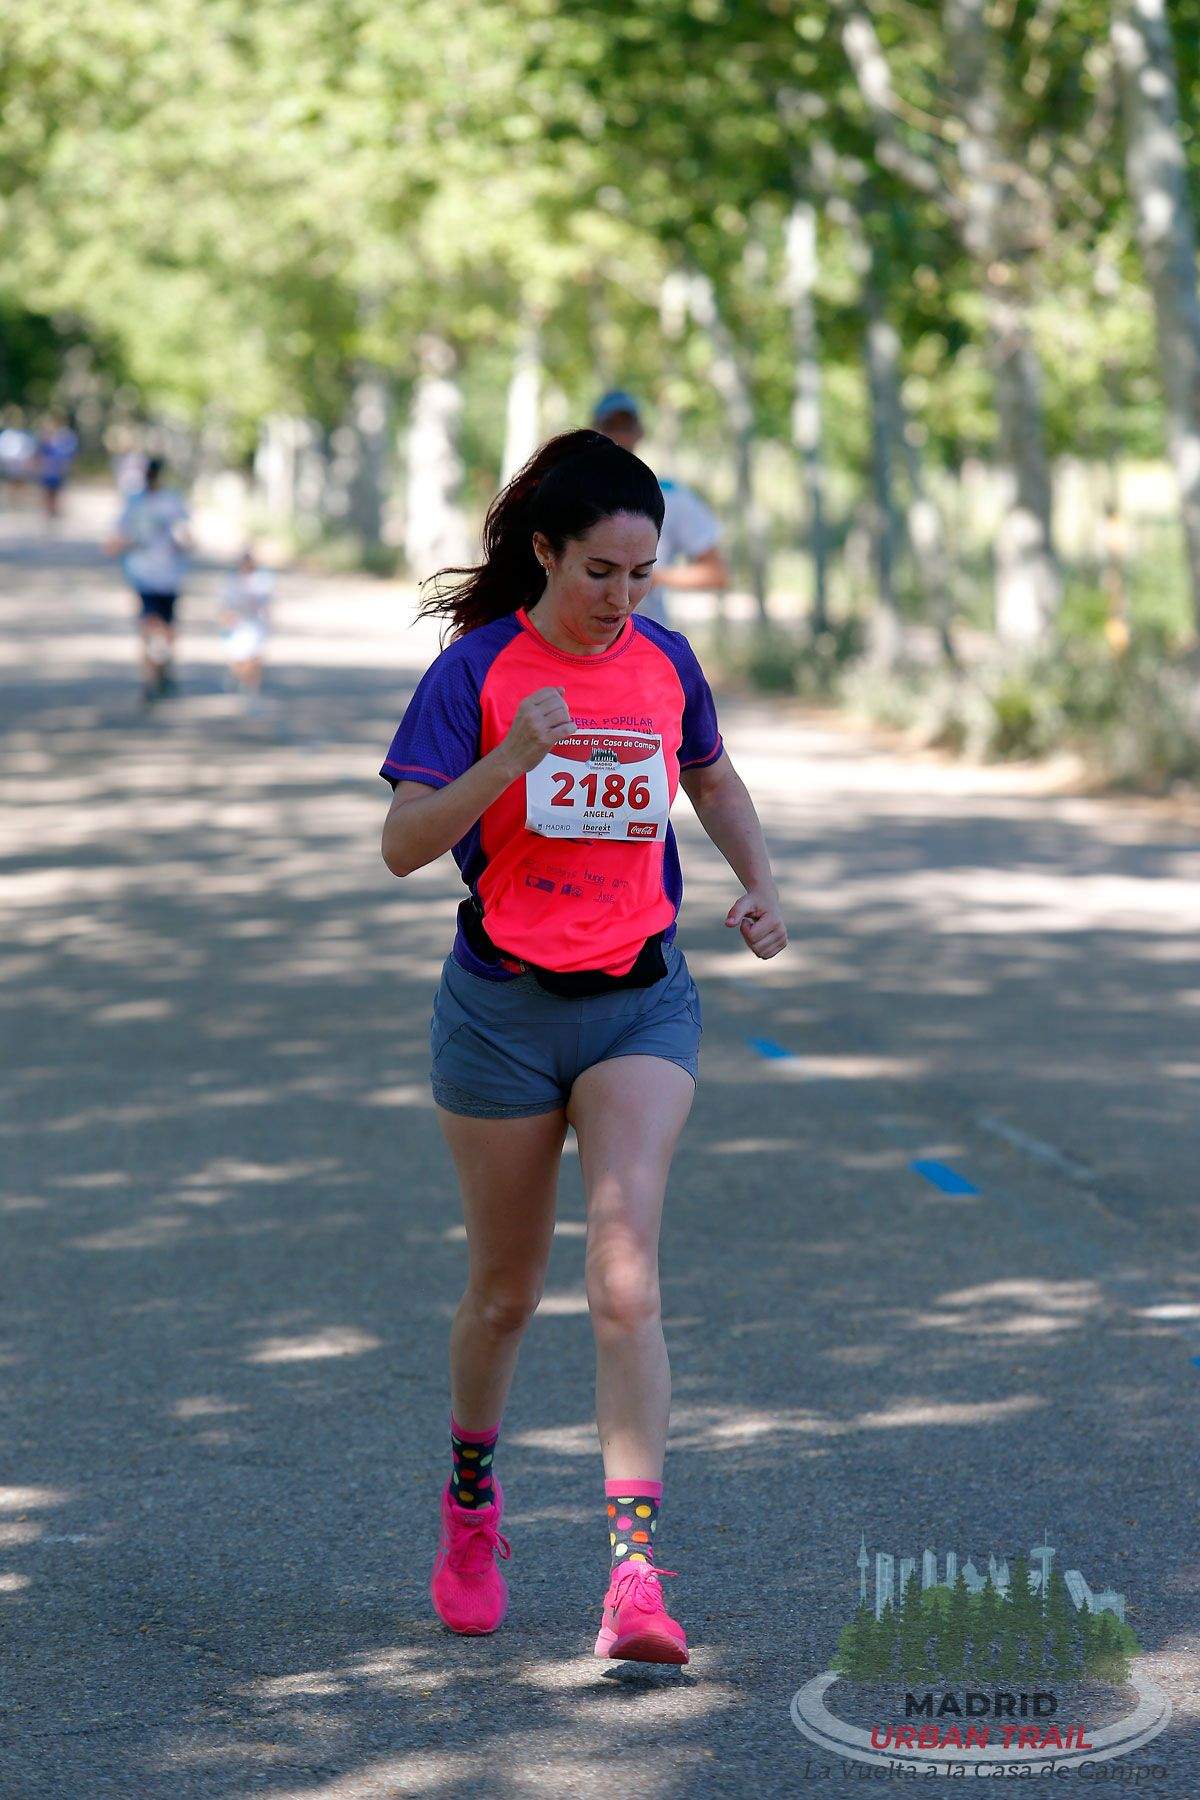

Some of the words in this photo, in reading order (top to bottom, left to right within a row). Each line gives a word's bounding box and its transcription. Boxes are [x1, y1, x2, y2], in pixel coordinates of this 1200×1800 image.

[603, 716, 653, 727] POPULAR
[591, 738, 600, 746] la
[603, 739, 622, 747] Casa
[624, 740, 633, 748] de
[634, 741, 656, 751] Campo
[550, 772, 650, 810] 2186
